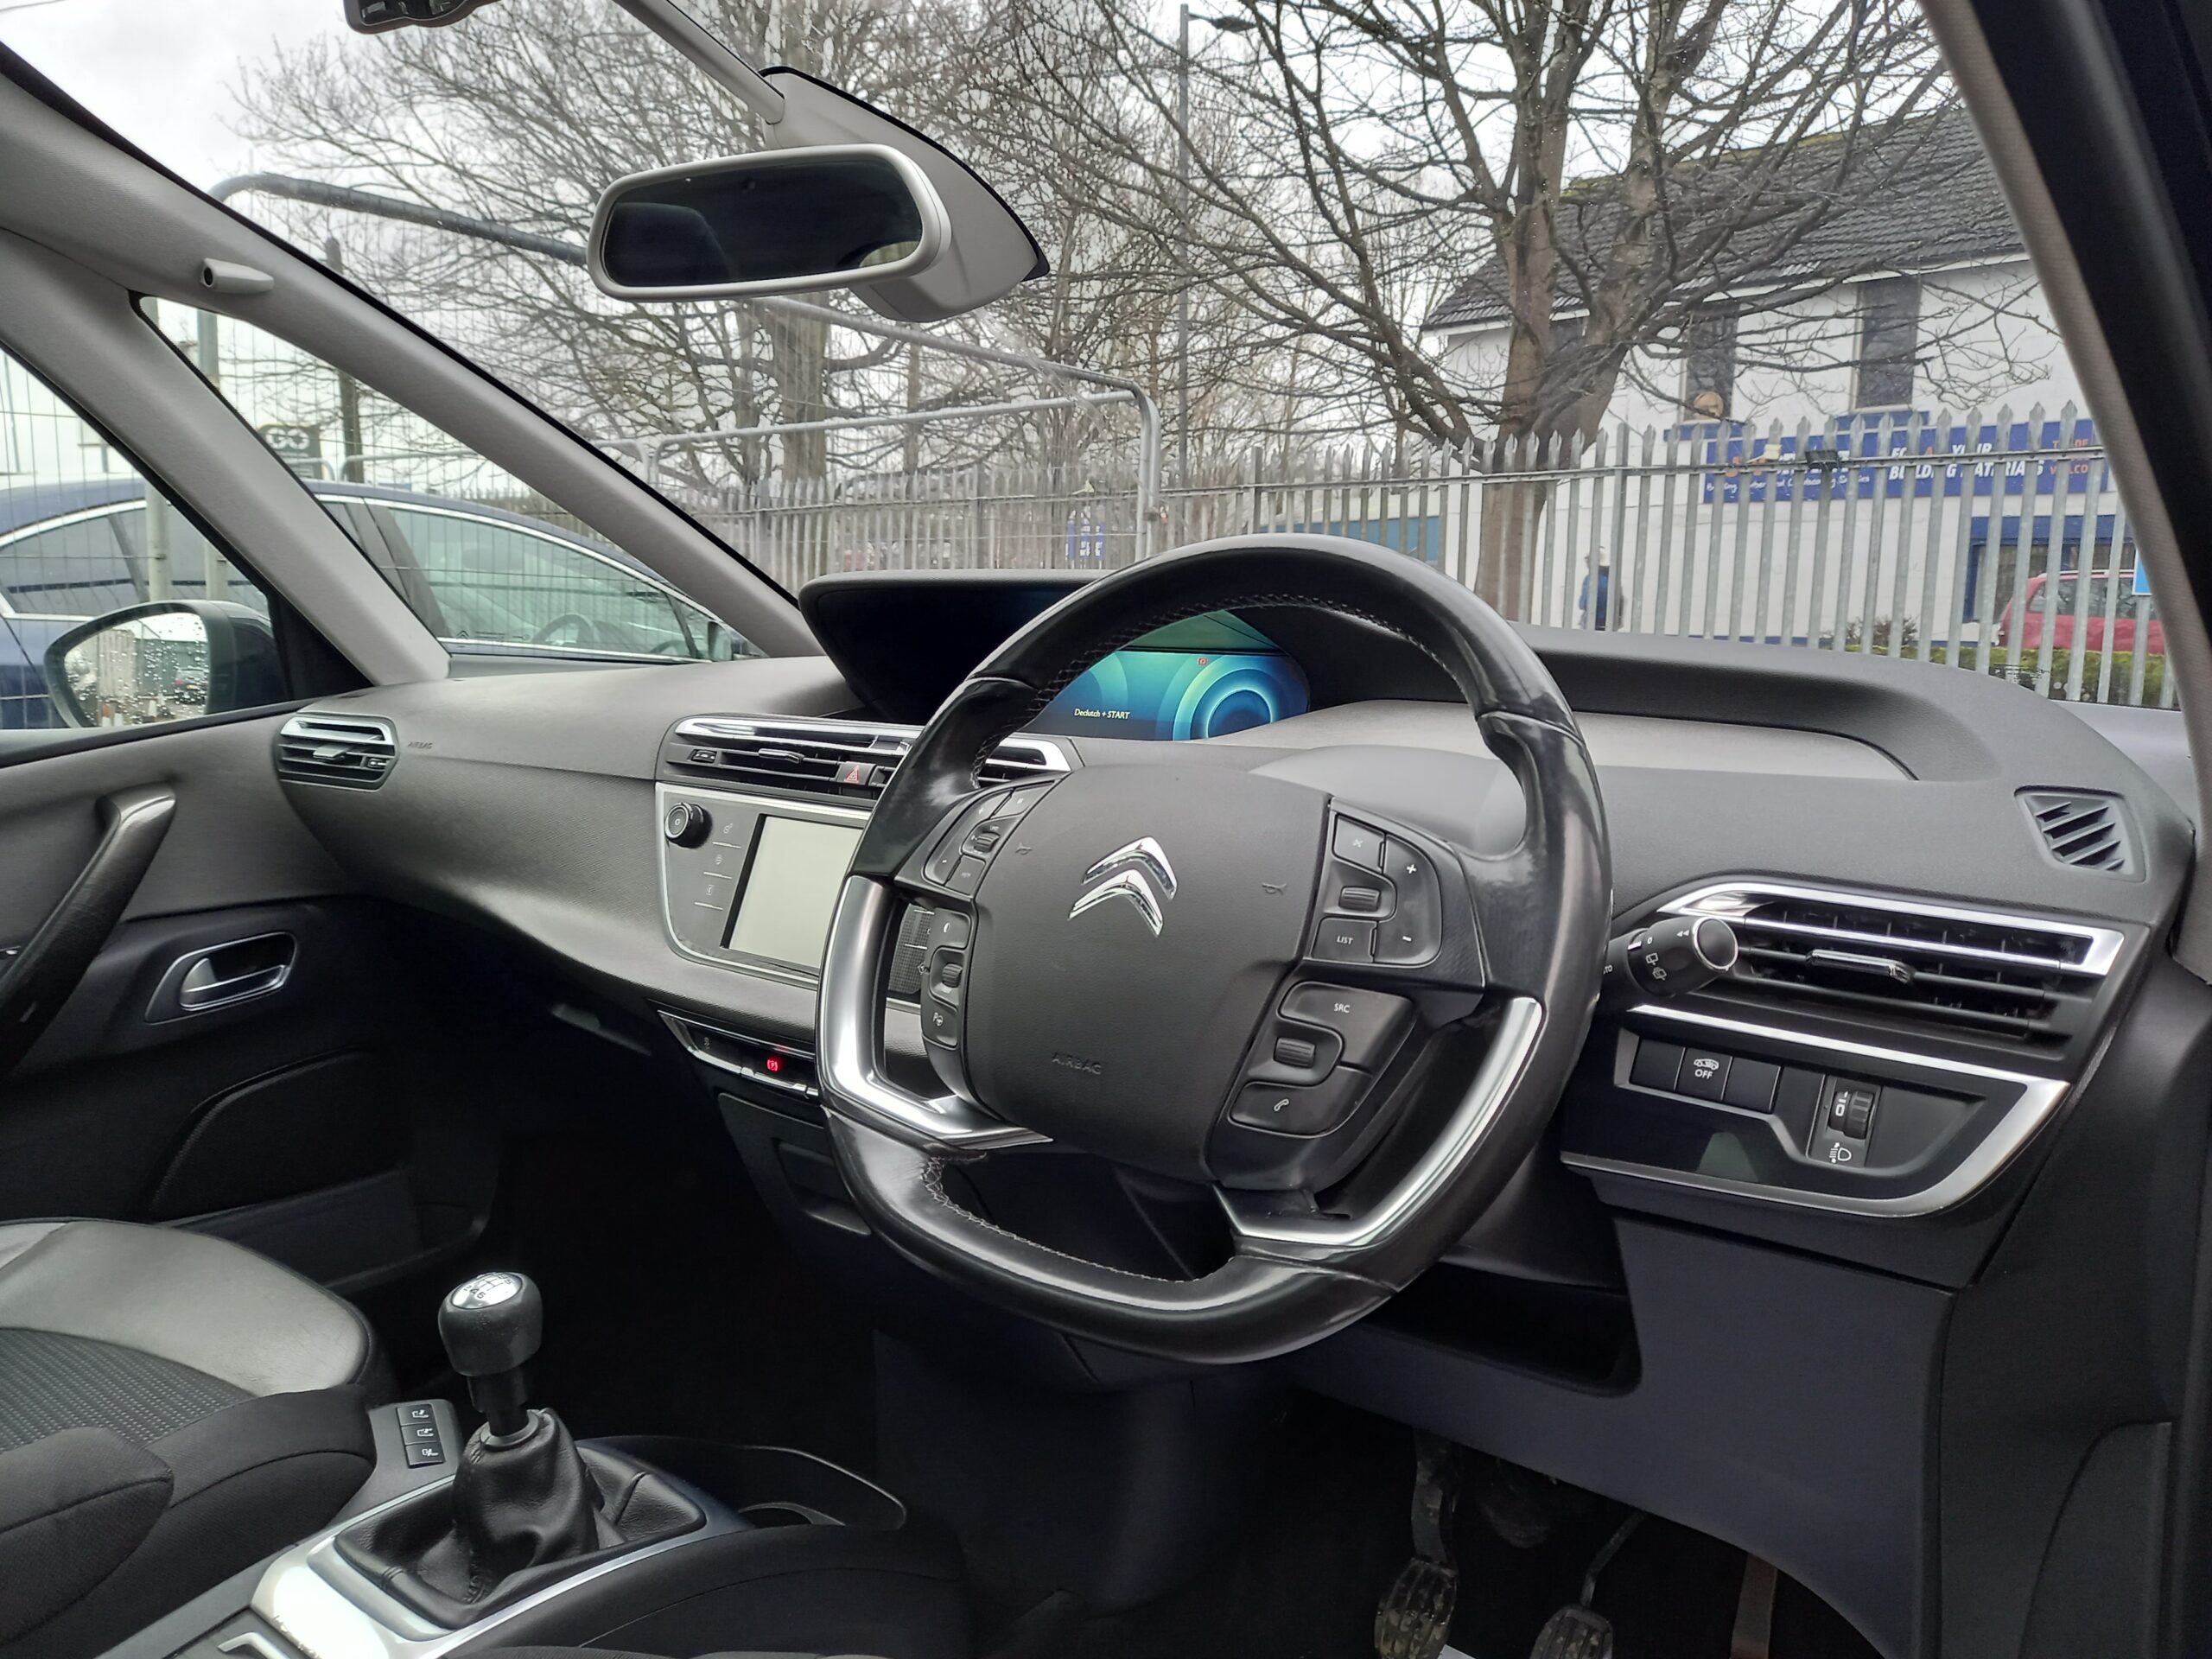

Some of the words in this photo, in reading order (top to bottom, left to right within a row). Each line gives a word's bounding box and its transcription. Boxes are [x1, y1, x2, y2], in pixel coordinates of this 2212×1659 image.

[265, 428, 309, 449] GO
[1074, 709, 1101, 717] Declutch
[1107, 710, 1130, 719] START
[1336, 936, 1353, 944] LIST
[1333, 1003, 1350, 1014] SRC
[1052, 1052, 1102, 1075] AIRBAG
[1694, 1069, 1713, 1079] OFF
